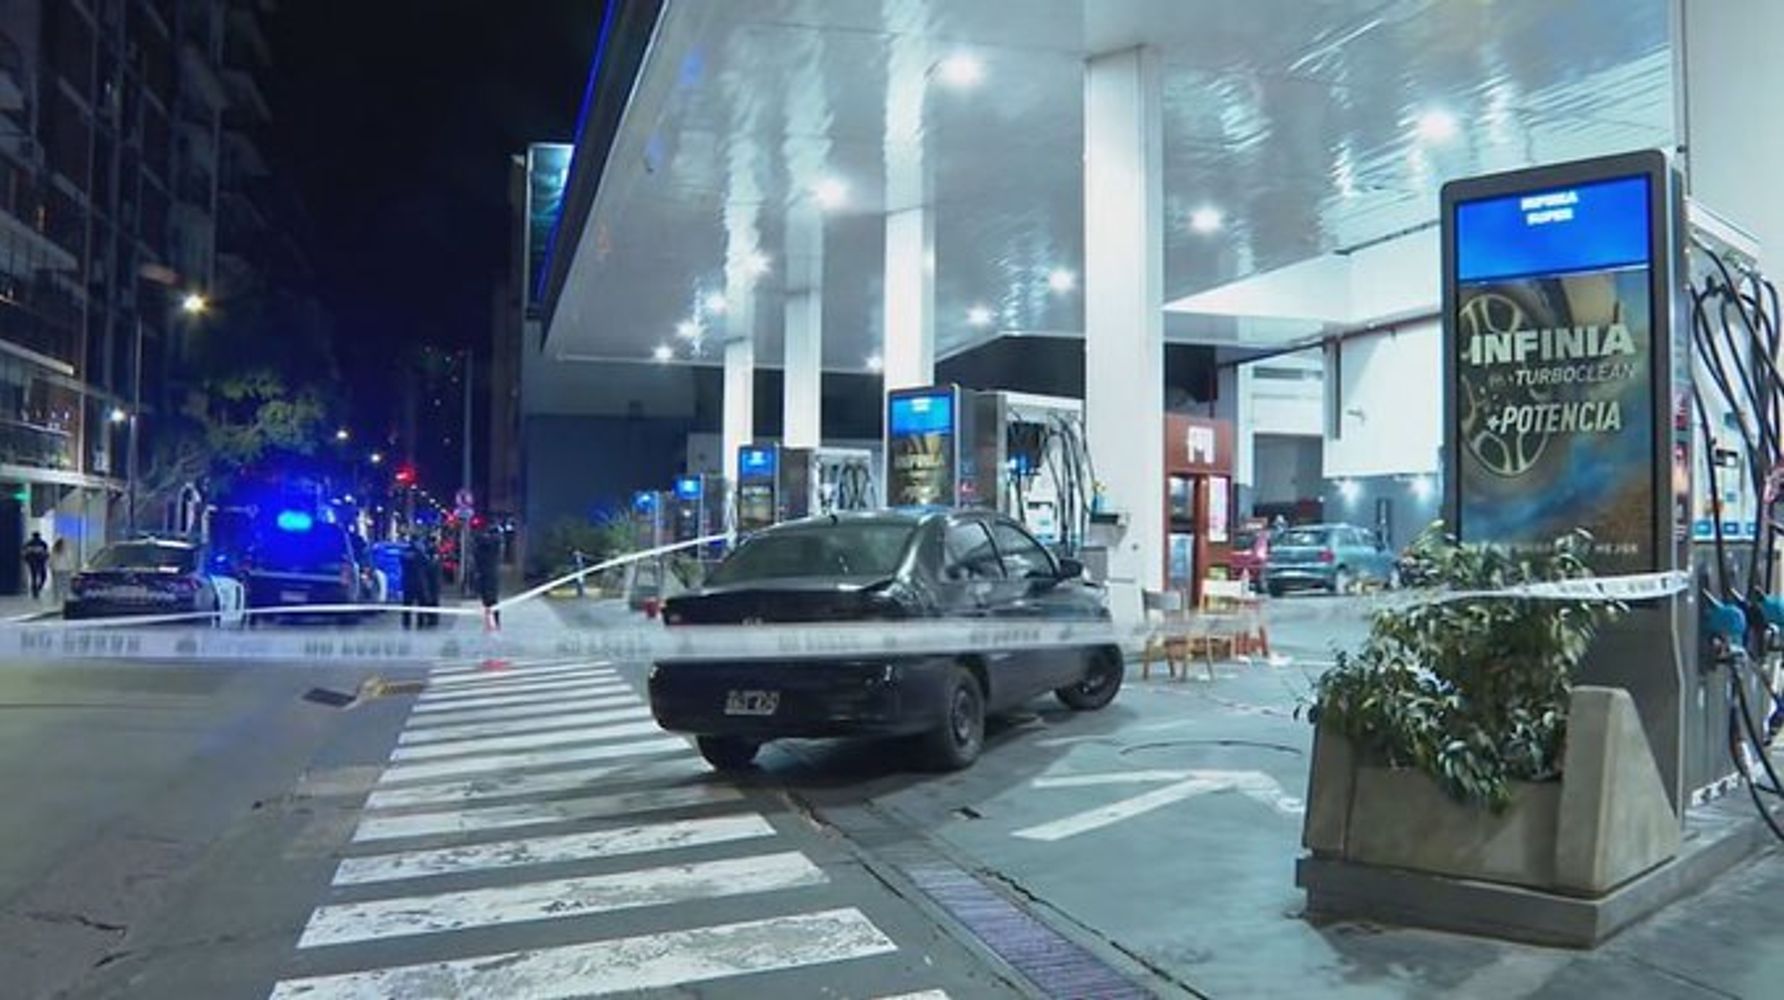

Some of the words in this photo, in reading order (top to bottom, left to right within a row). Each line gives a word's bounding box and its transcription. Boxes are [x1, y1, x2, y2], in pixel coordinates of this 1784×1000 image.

[1470, 323, 1637, 366] INFINIA
[1514, 362, 1636, 386] TURBOCLEAN
[1487, 401, 1622, 435] +POTENCIA
